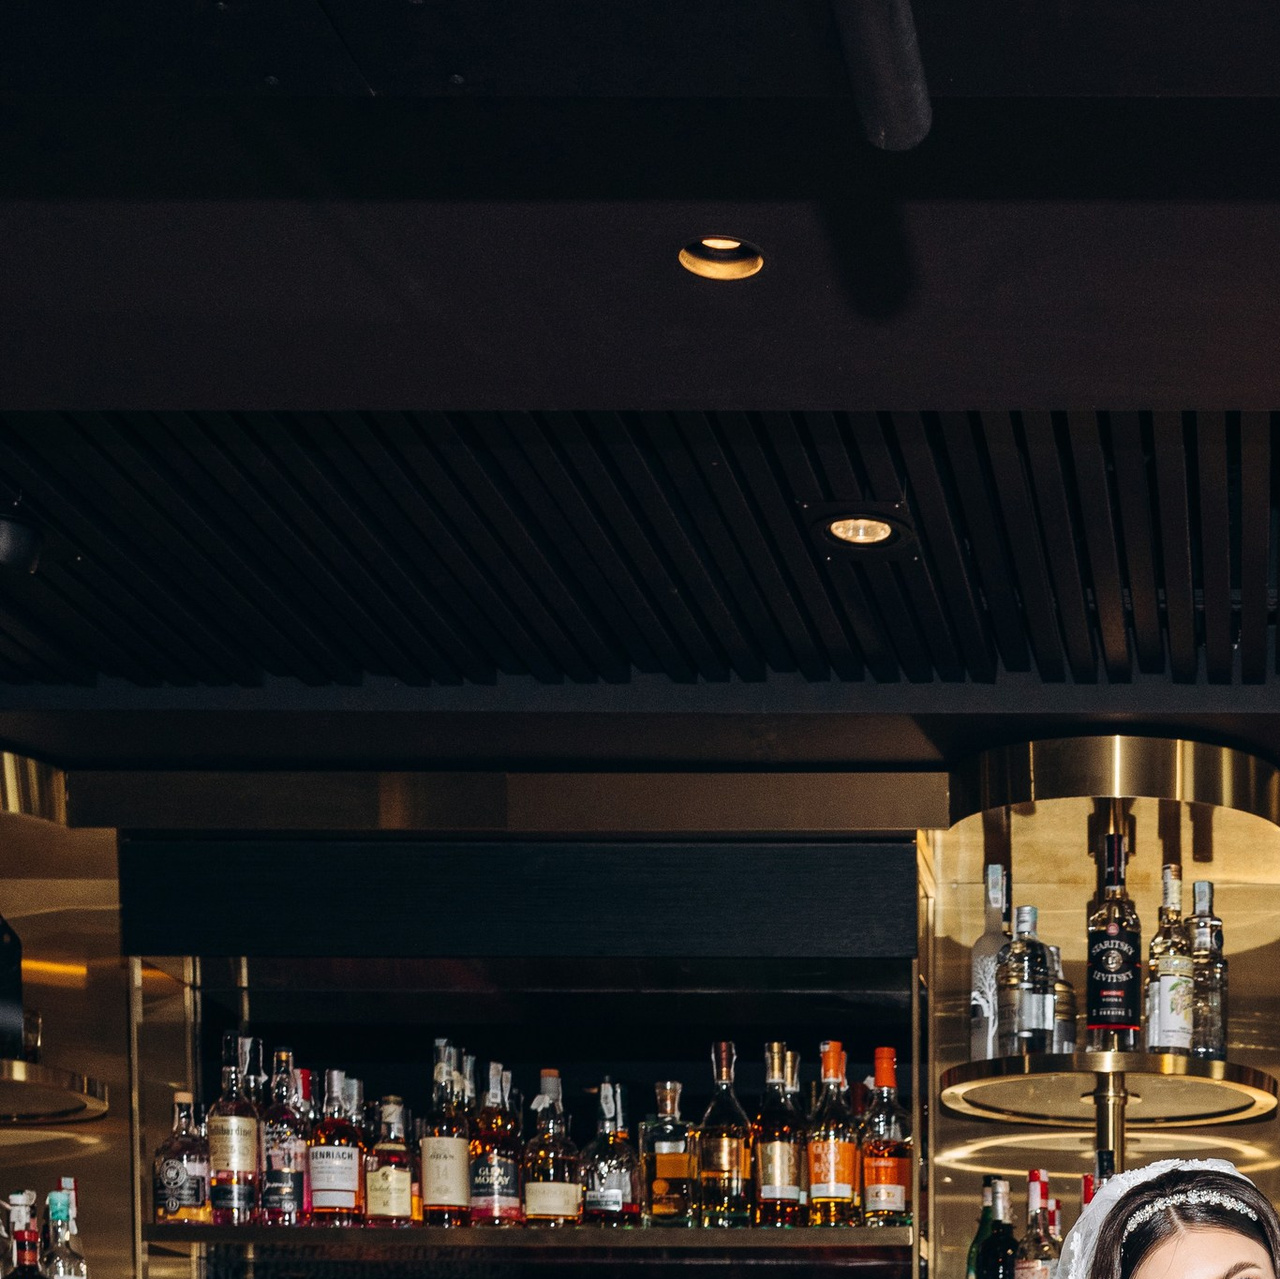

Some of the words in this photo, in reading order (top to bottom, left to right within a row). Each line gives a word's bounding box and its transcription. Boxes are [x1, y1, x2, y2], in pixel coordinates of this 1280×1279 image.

[1090, 939, 1136, 957] STARITSKY
[1092, 970, 1135, 984] LEVITSKY
[478, 1166, 506, 1176] GLEN
[474, 1175, 512, 1186] MORAY
